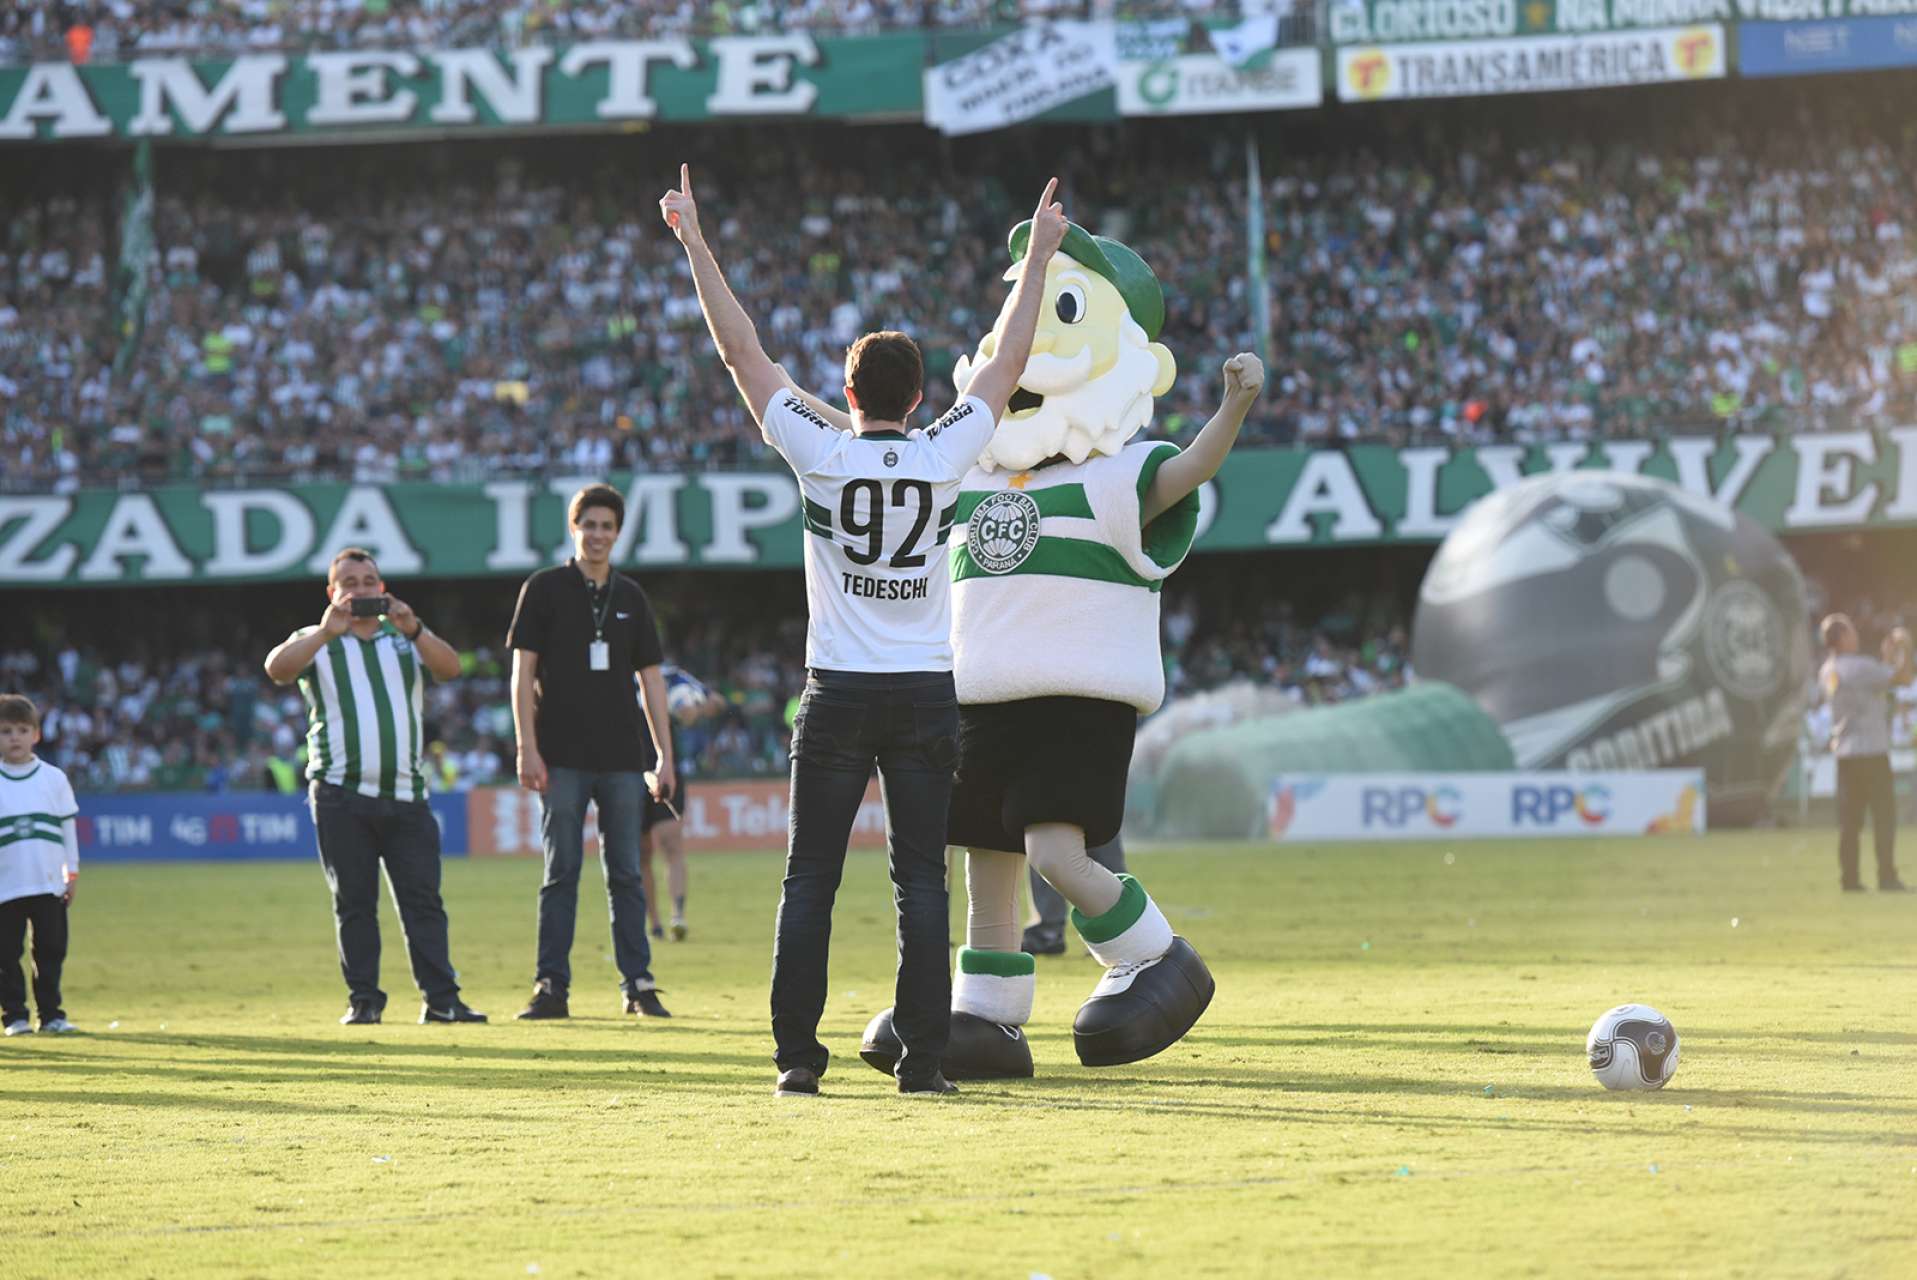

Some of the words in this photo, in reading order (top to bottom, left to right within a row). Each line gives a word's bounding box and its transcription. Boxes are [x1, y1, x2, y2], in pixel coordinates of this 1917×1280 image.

[0, 36, 819, 138] AMENTE
[1398, 40, 1666, 93] TRANSAMÉRICA
[840, 478, 932, 568] 92
[969, 504, 990, 554] CORITIBA
[1023, 523, 1039, 551] CLUB
[981, 519, 1024, 541] CFC
[842, 572, 928, 600] TEDESCHI
[1362, 784, 1464, 827] RPC
[1512, 783, 1610, 826] RPC
[95, 815, 152, 847] TIM
[240, 813, 299, 844] TIM
